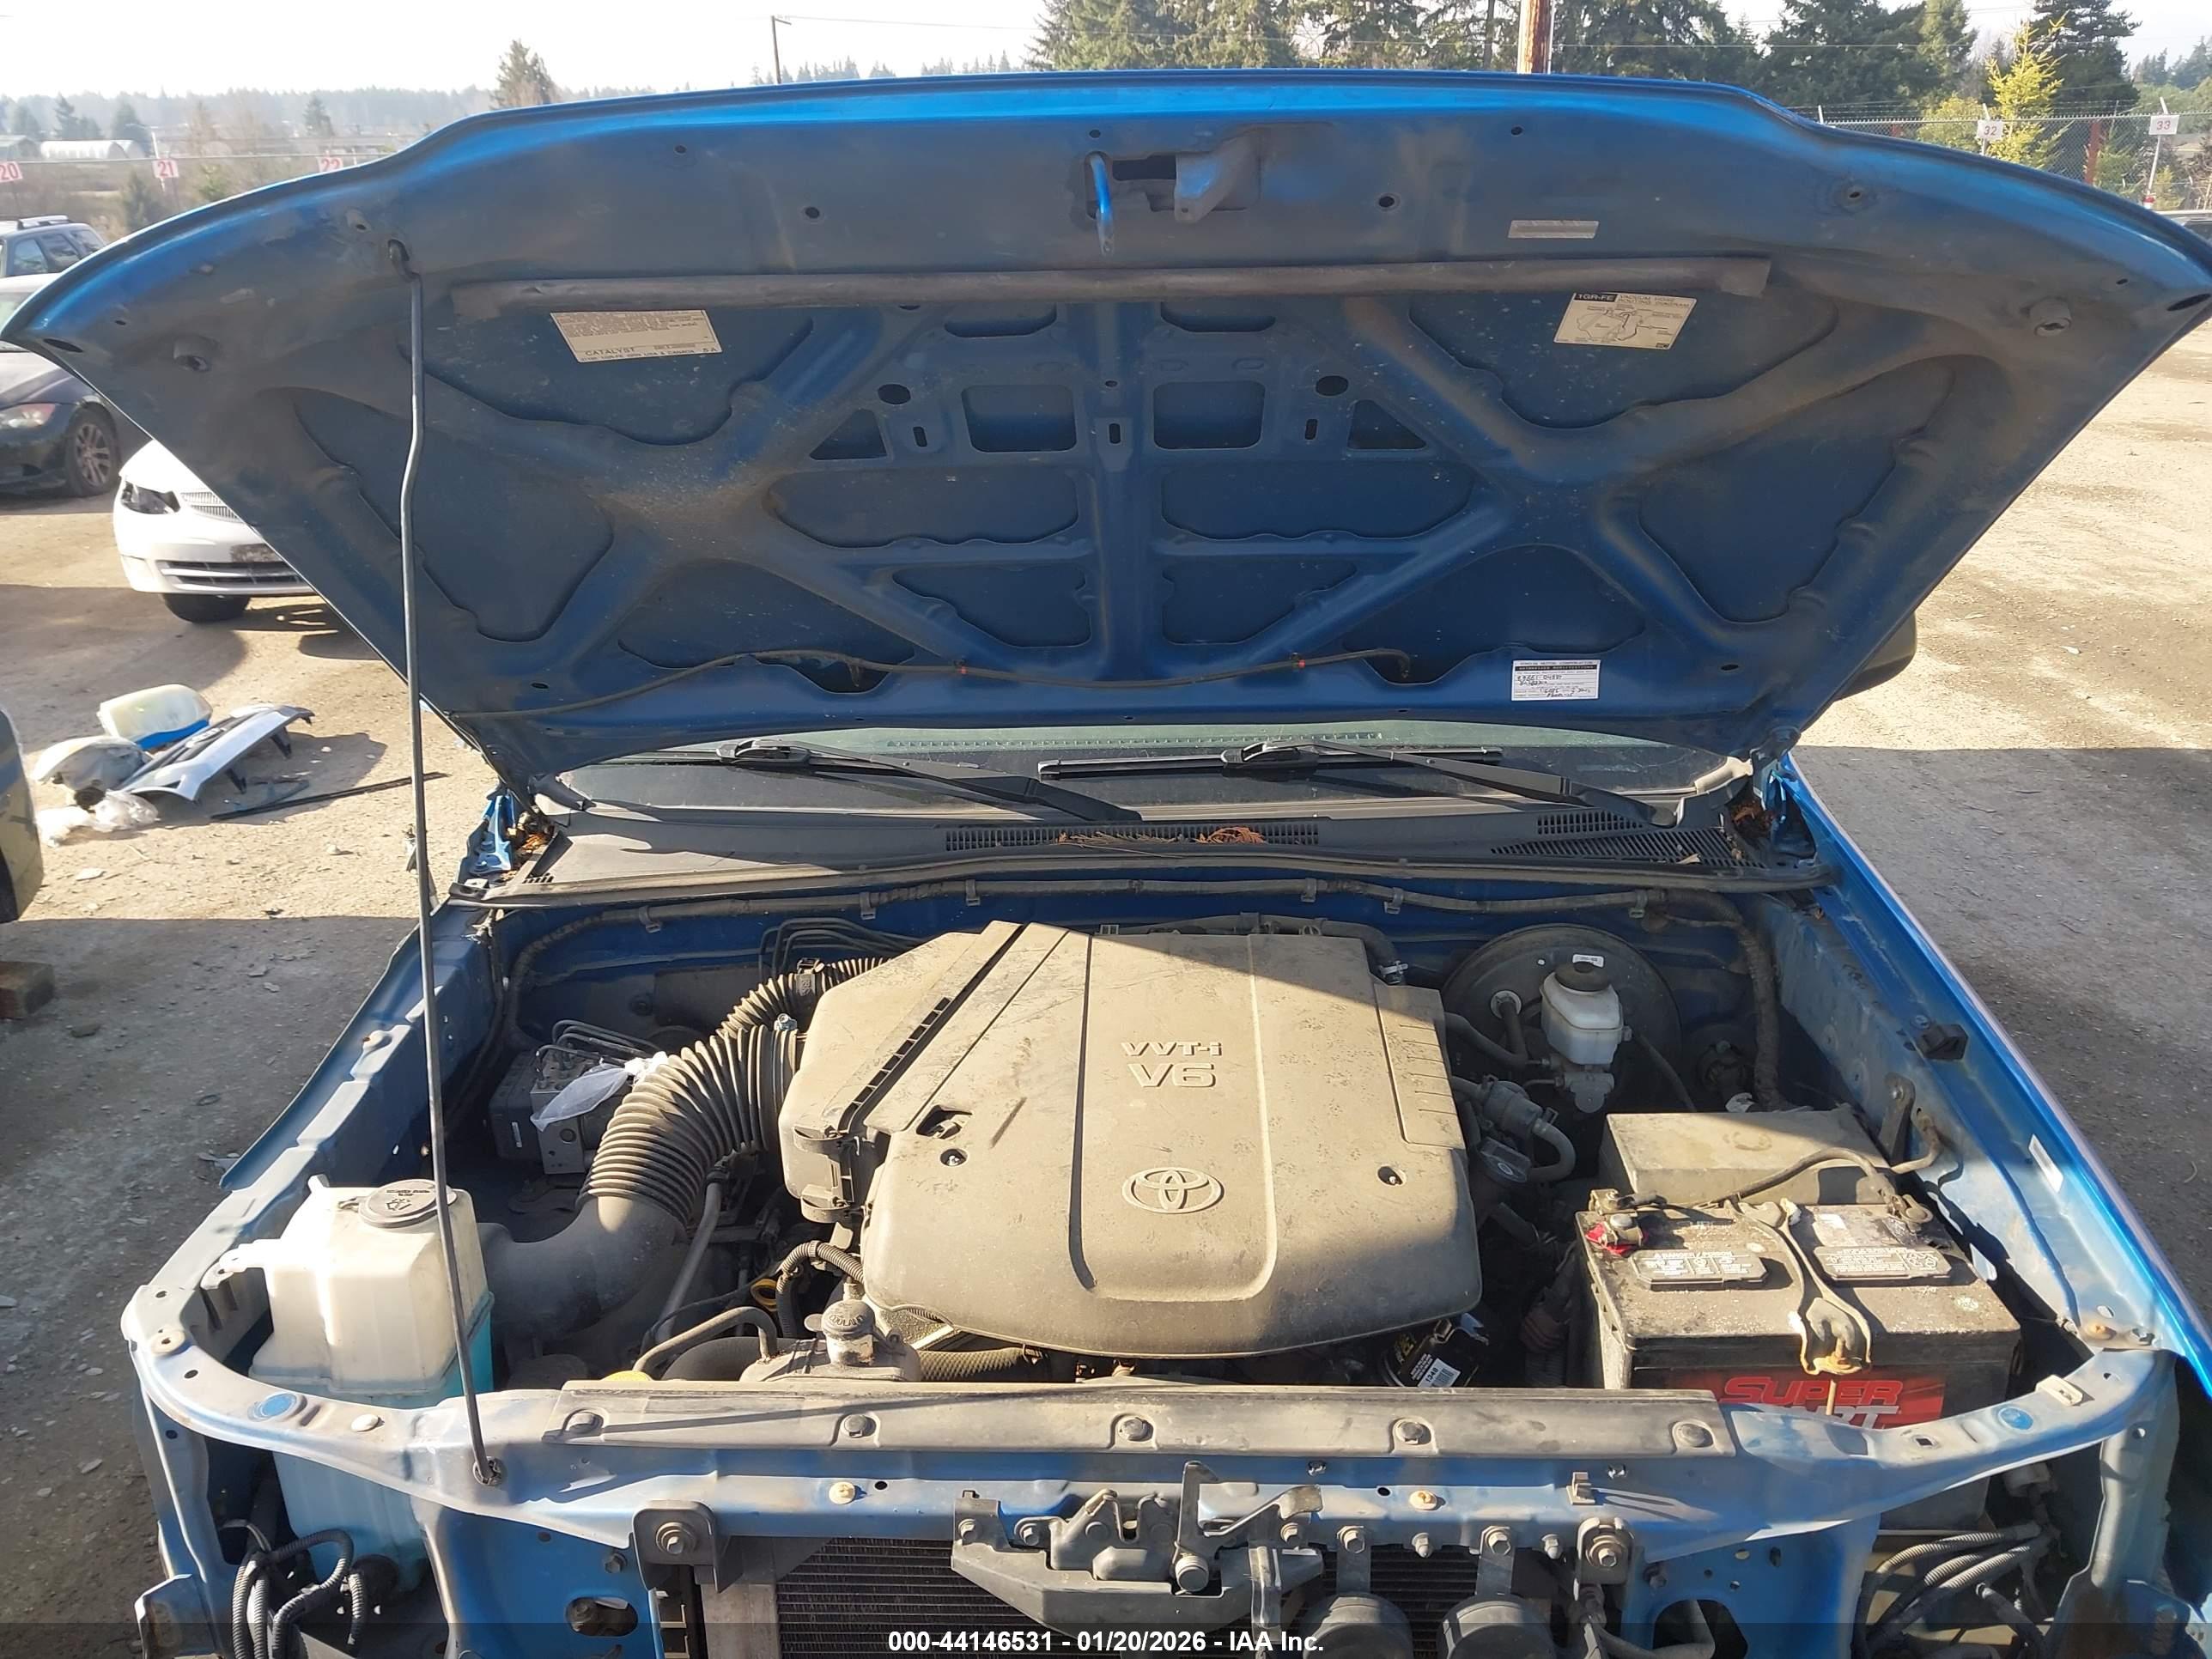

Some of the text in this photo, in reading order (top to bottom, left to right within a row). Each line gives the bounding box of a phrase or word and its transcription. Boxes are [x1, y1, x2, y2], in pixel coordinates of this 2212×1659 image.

[1984, 125, 1997, 136] 32
[2156, 120, 2171, 130] 33
[0, 163, 19, 180] 20
[157, 161, 173, 176] 21
[585, 346, 635, 356] CATALYST
[1127, 1062, 1217, 1088] V6
[1719, 1376, 1903, 1406] SUPER
